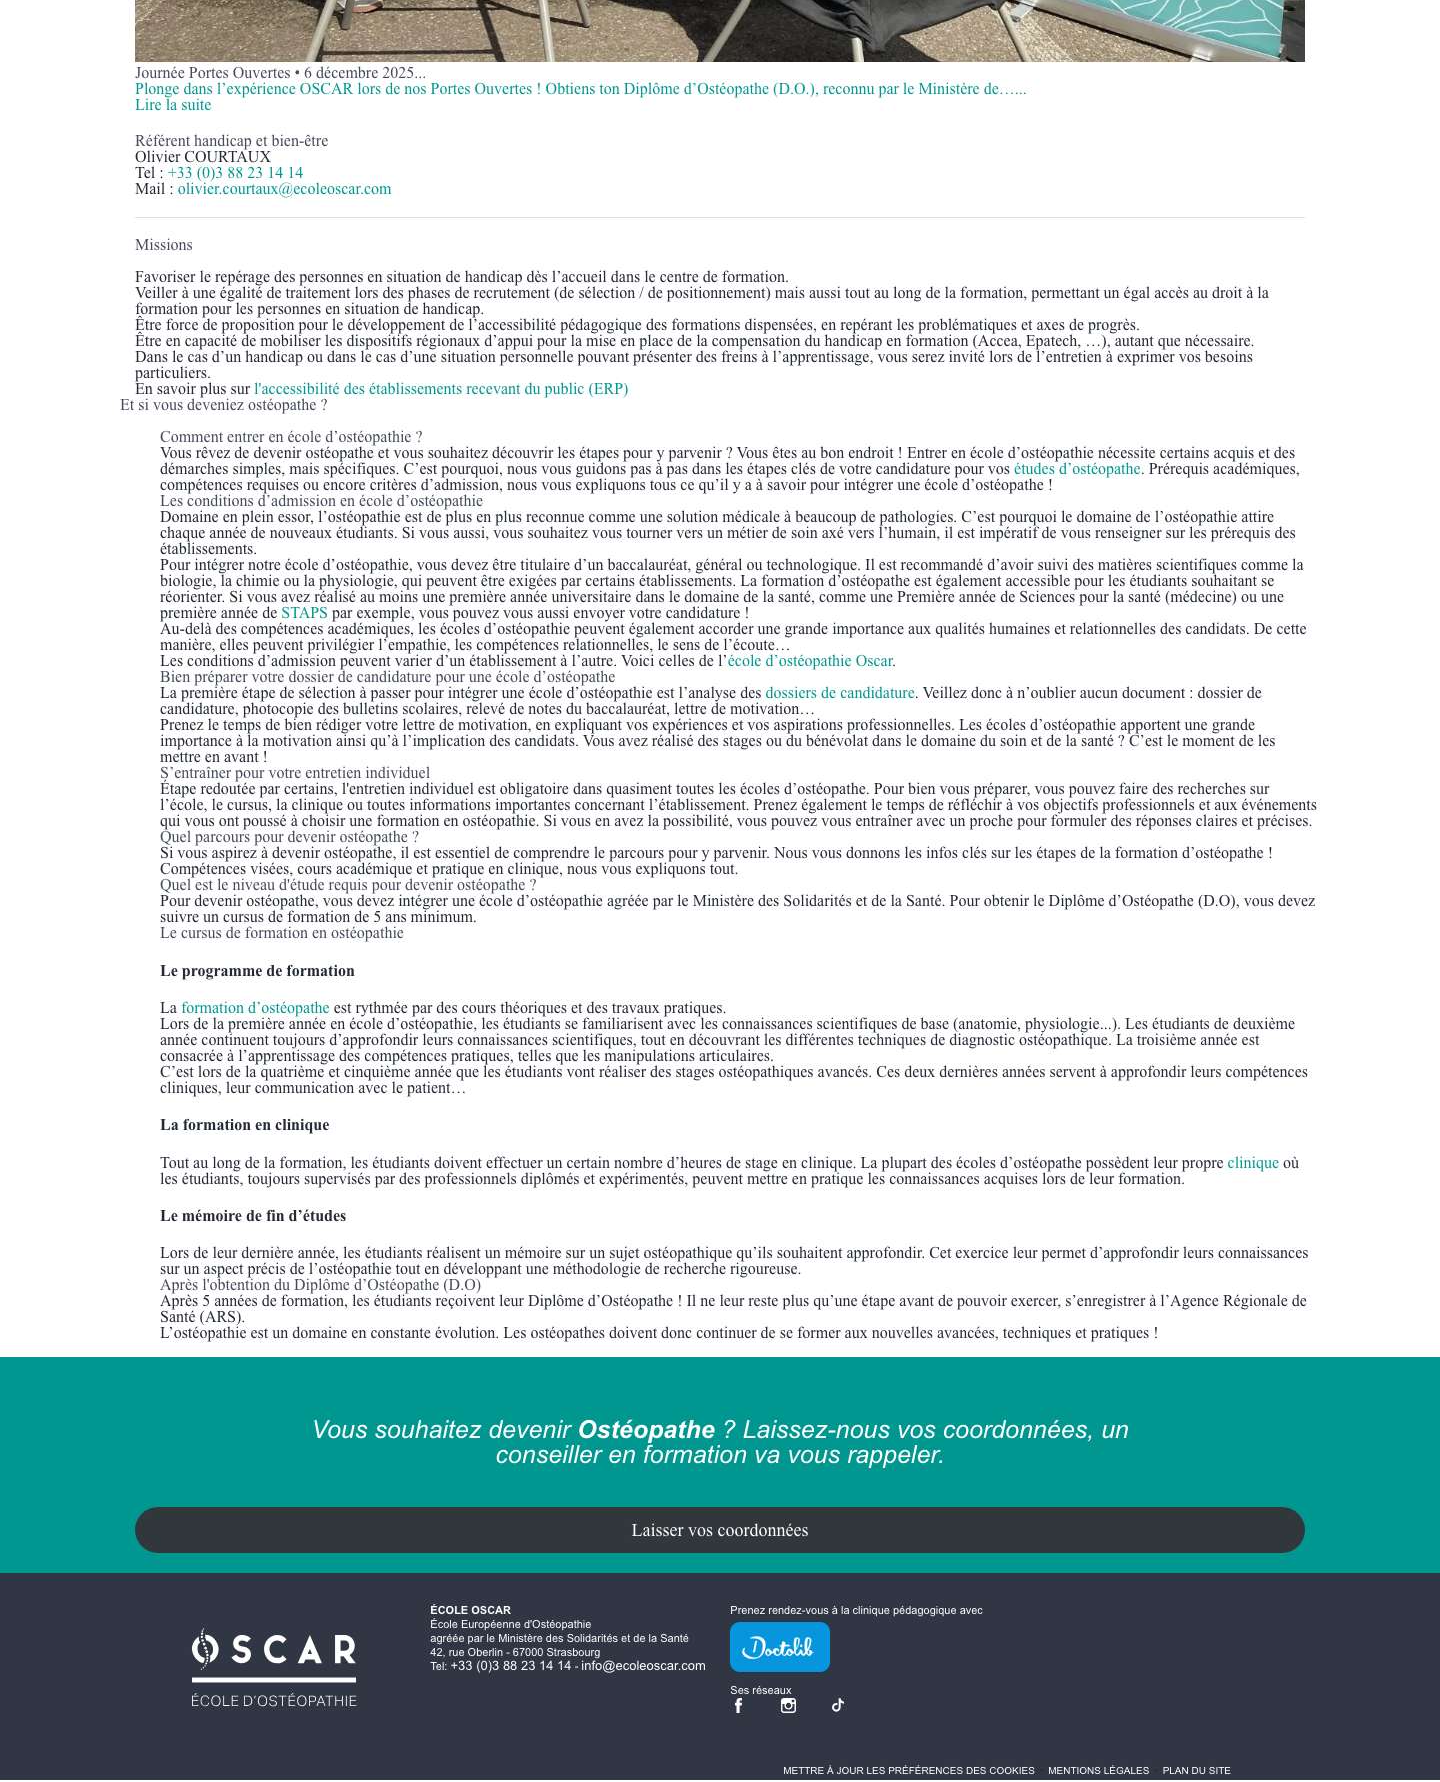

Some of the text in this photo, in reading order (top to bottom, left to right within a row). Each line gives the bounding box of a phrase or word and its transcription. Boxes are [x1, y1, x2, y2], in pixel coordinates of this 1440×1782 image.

[134, 148, 272, 164] Olivier COURTAUX
[159, 963, 356, 981] Le programme de formation
[313, 1418, 1129, 1445] Vous souhaitez devenir Ostéopathe ? Laissez-nous vos coordonnées, un
[631, 1522, 809, 1538] Laisser vos coordonnées
[430, 1603, 512, 1615] ÉCOLE OSCAR
[191, 1627, 356, 1671] OSCAR
[741, 1635, 815, 1660] Doctolib
[730, 1685, 792, 1695] Ses réseaux
[191, 1692, 357, 1707] ÉCOLE D’OSTÉOPATHIE
[1162, 1766, 1232, 1775] PLAN DU SITE
